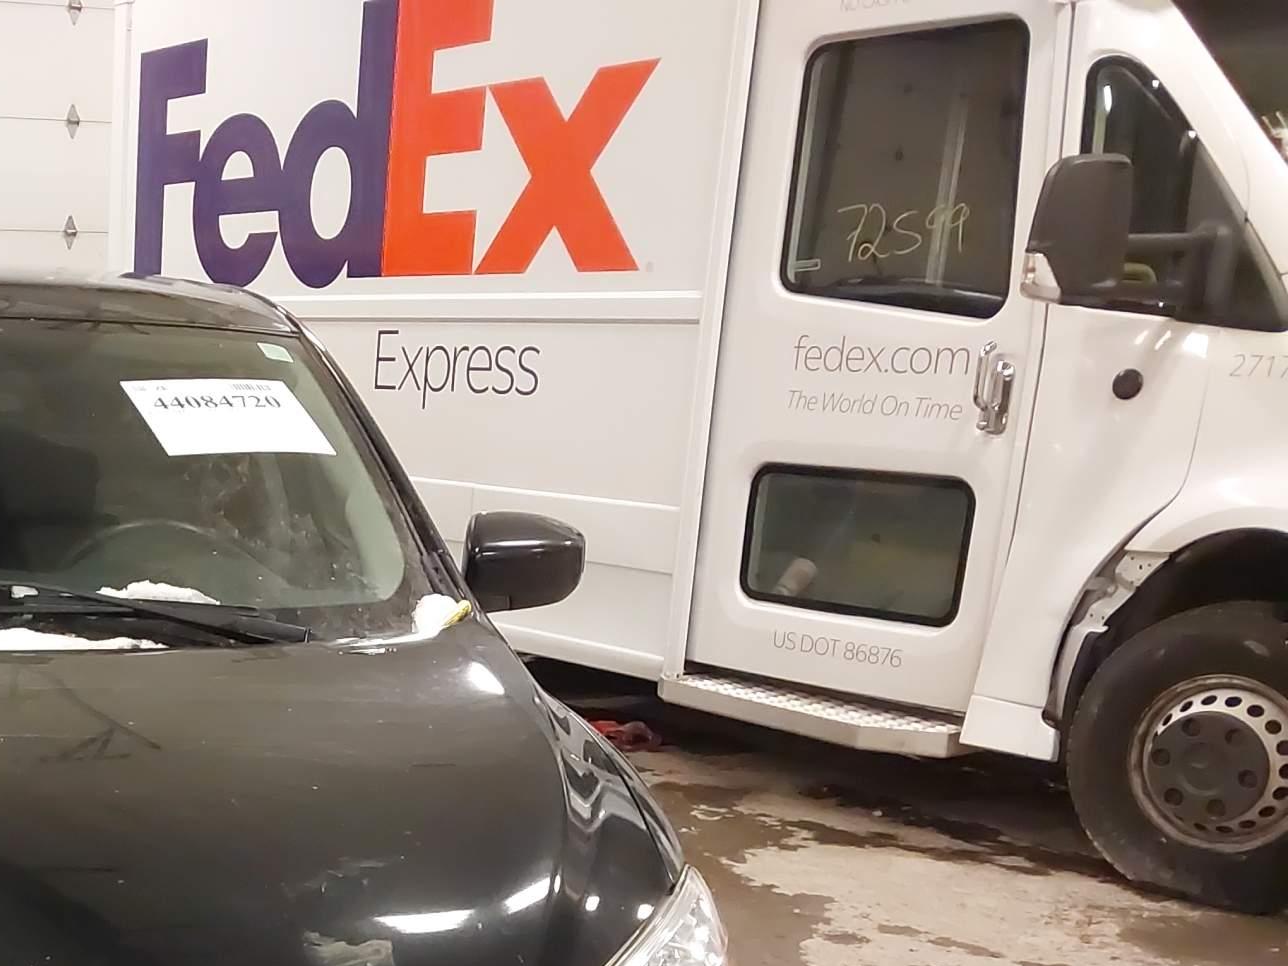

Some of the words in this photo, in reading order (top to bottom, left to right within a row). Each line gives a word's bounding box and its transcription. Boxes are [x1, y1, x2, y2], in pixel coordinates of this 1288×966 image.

[134, 0, 661, 289] FedEx
[374, 330, 540, 410] Express
[793, 334, 971, 375] fedex.com
[153, 395, 282, 409] 44084720
[787, 389, 818, 412] The
[822, 392, 878, 415] World
[880, 395, 910, 417] On
[914, 396, 963, 421] Time
[773, 630, 797, 651] US
[800, 633, 841, 657] DOT
[843, 641, 904, 668] 86876
